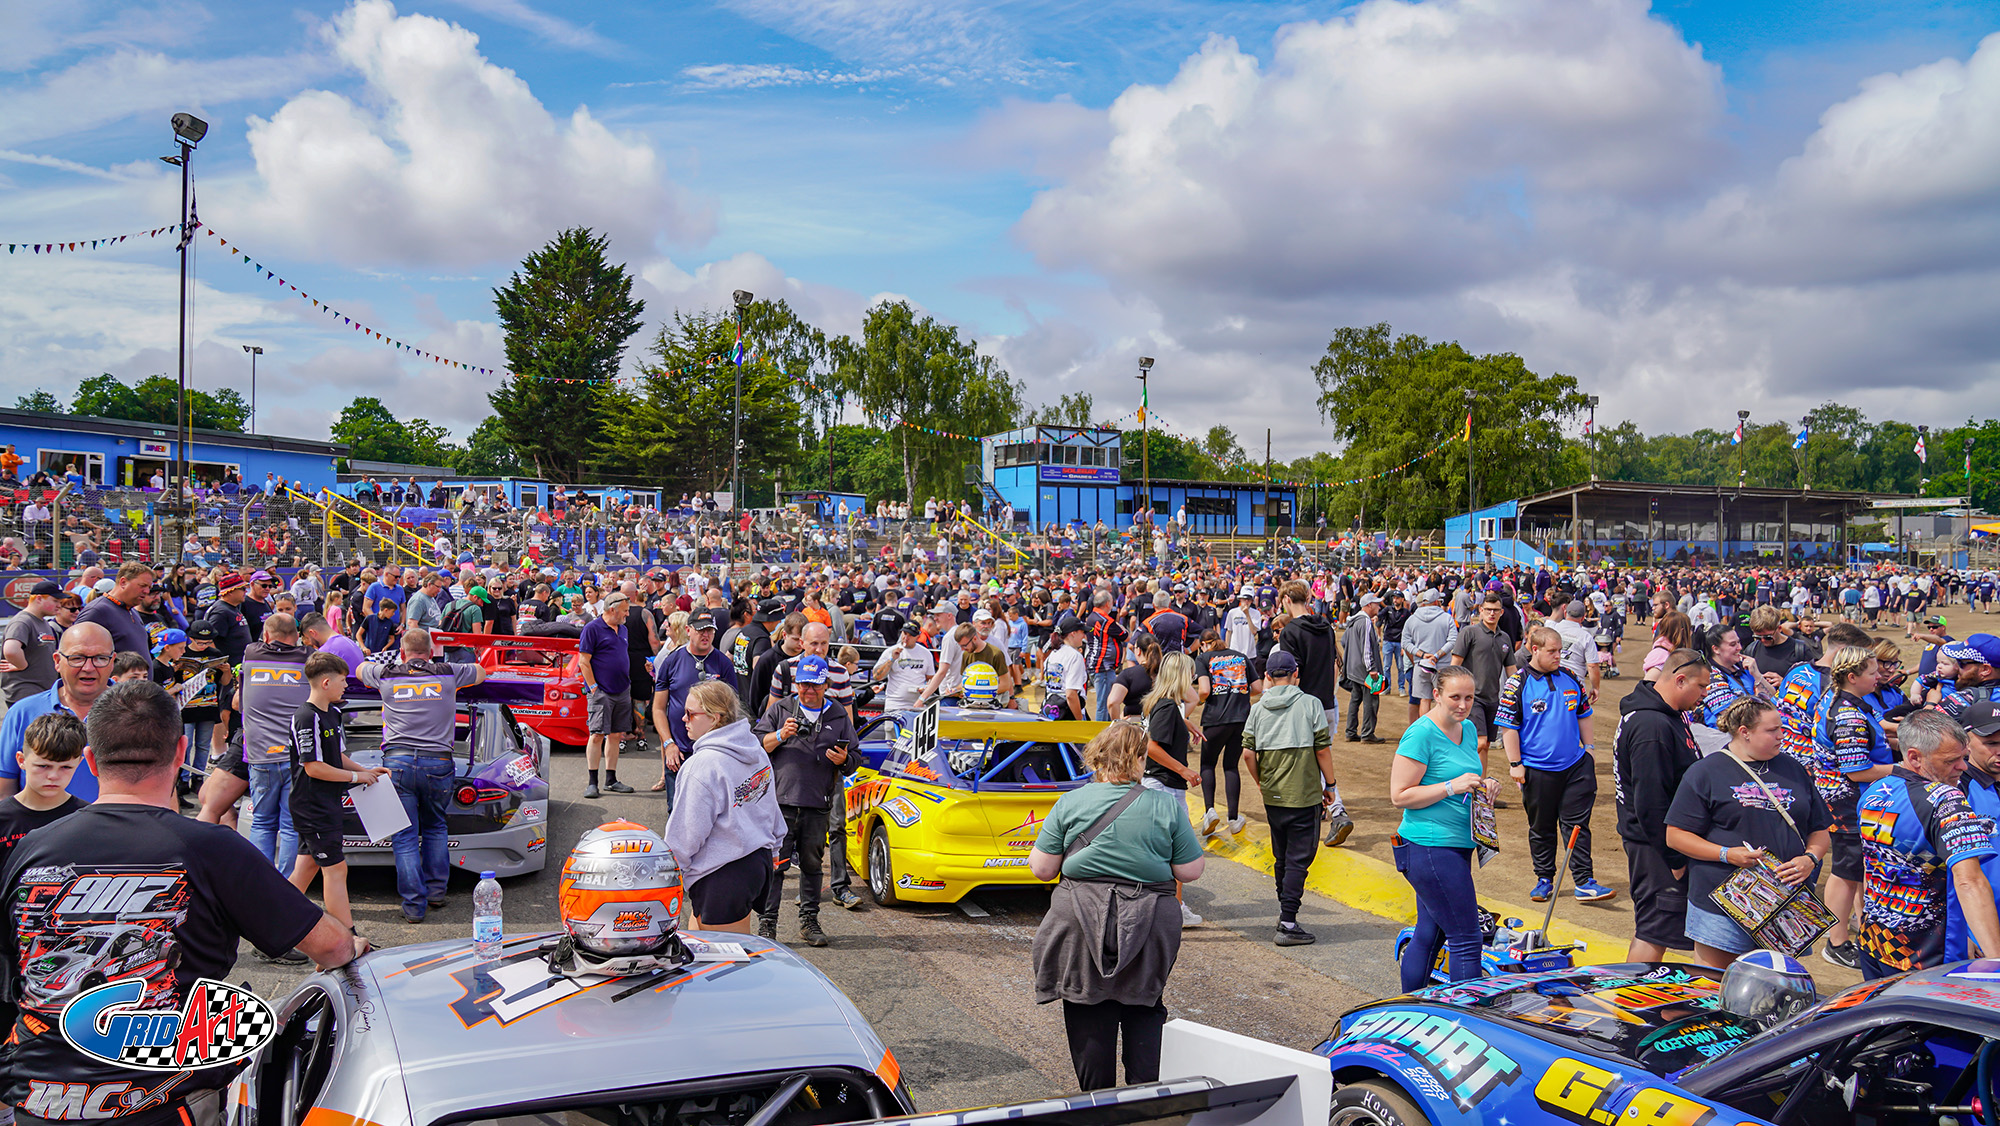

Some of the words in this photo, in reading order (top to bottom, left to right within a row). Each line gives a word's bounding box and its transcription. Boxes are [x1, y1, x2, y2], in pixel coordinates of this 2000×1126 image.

[846, 778, 892, 820] AUTO
[1863, 795, 1895, 809] Team
[610, 840, 654, 855] 907
[55, 876, 179, 914] 907
[1328, 1010, 1520, 1103] SMART
[1360, 1090, 1405, 1126] Hoos
